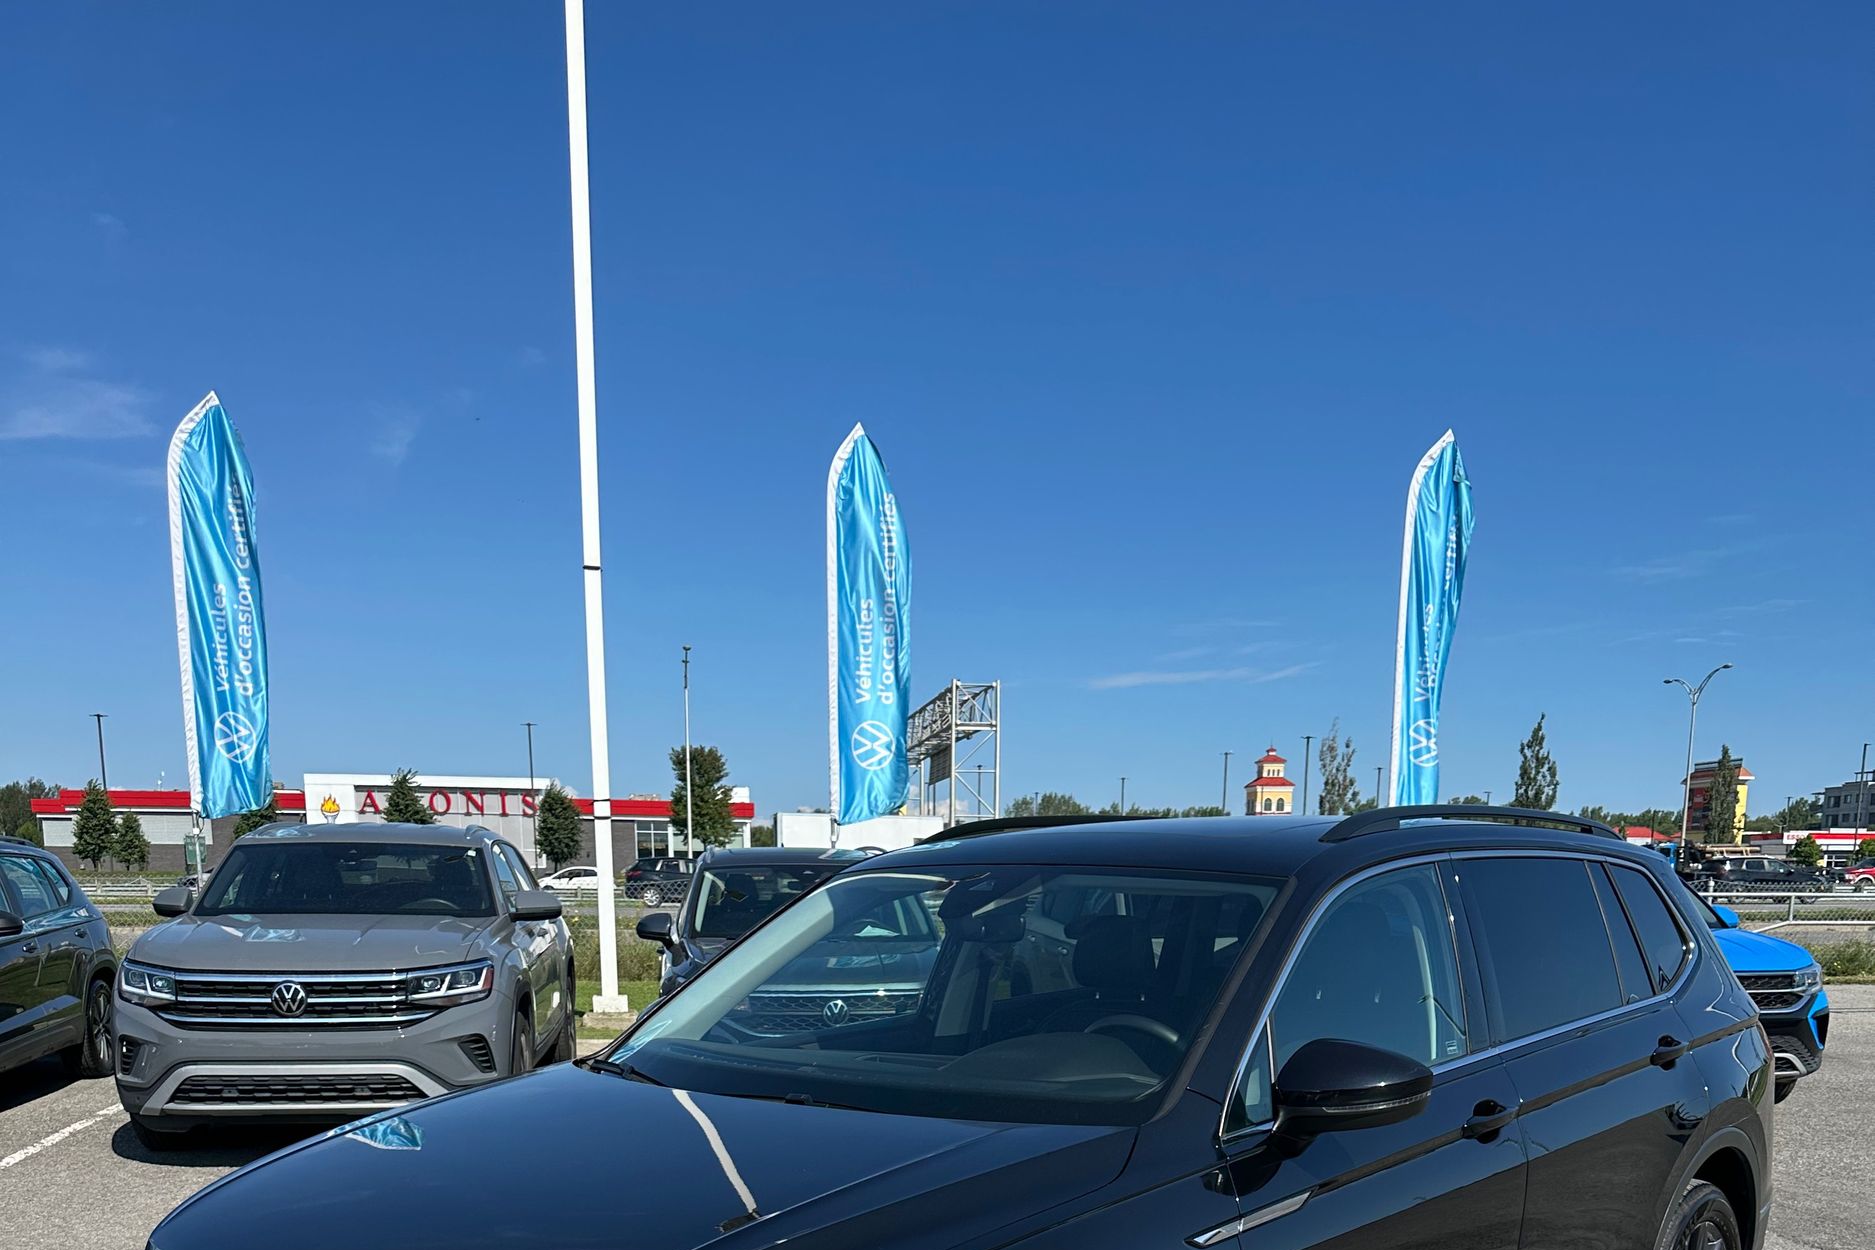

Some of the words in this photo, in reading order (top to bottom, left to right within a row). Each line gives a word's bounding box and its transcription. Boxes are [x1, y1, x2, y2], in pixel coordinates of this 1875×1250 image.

[211, 583, 230, 692] Véhicules
[234, 575, 254, 696] d'occasion
[856, 598, 873, 704] Véhicules
[877, 588, 896, 705] d'occasion
[358, 788, 540, 817] AONIS
